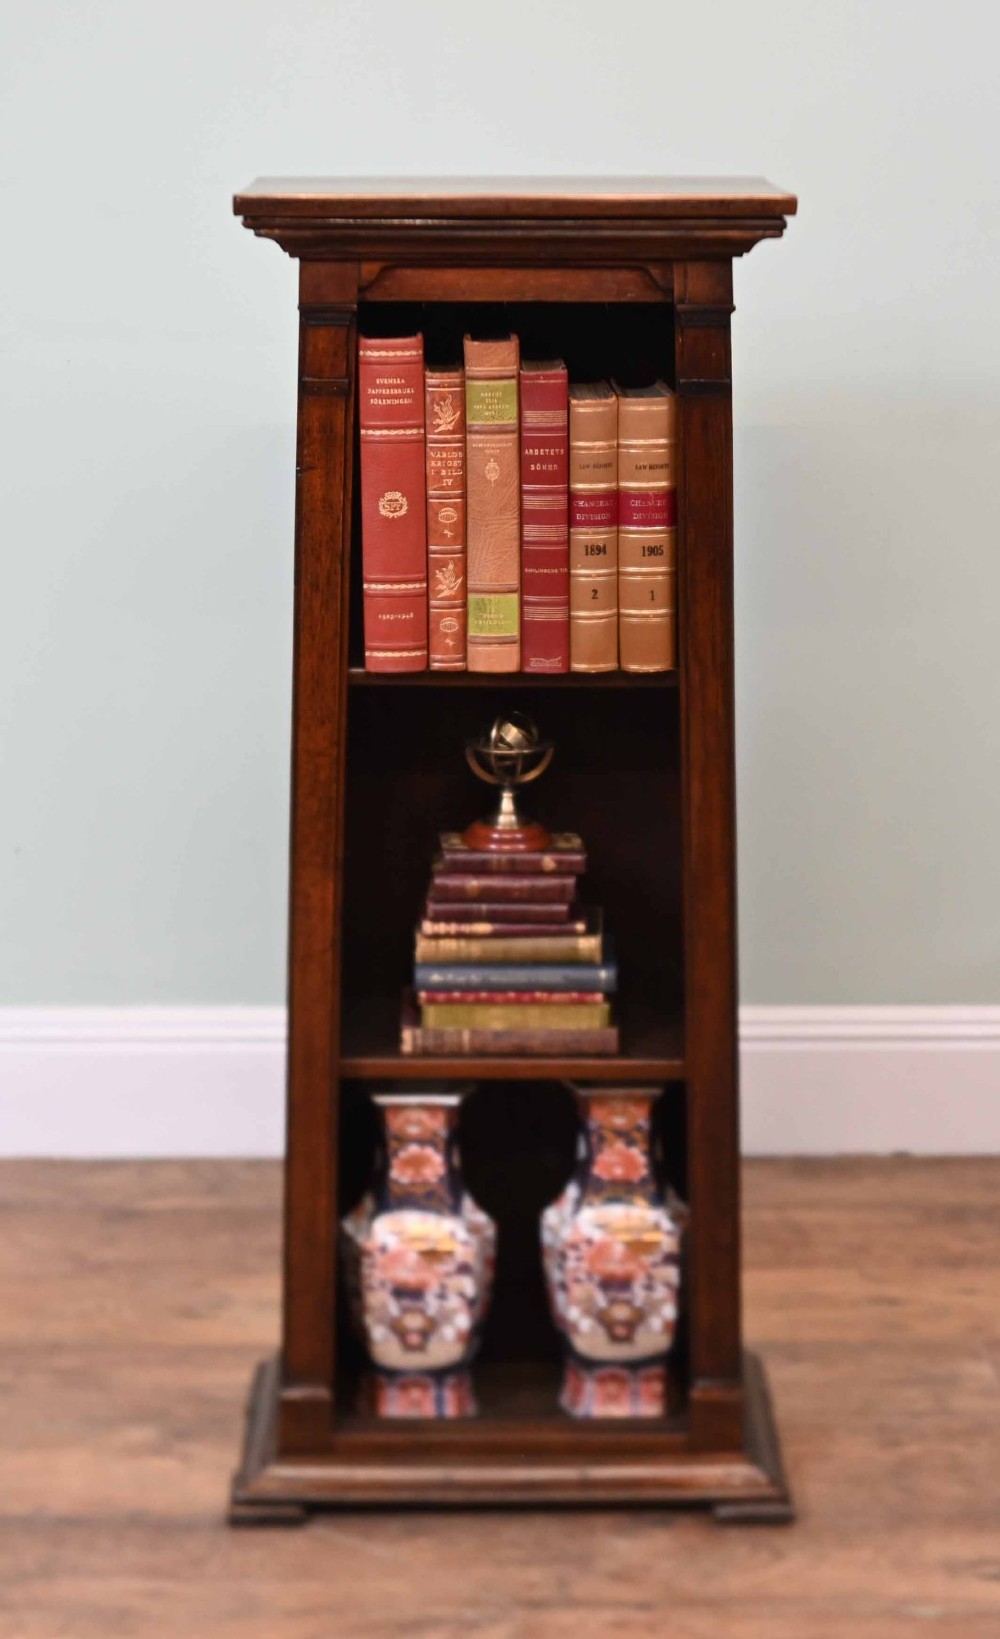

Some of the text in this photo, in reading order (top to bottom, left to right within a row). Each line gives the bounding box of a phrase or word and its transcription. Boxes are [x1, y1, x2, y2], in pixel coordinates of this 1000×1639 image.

[524, 448, 565, 456] ARBETETS
[584, 543, 607, 557] 1894
[641, 544, 664, 558] 1905
[591, 588, 599, 600] 2
[650, 589, 656, 602] 1
